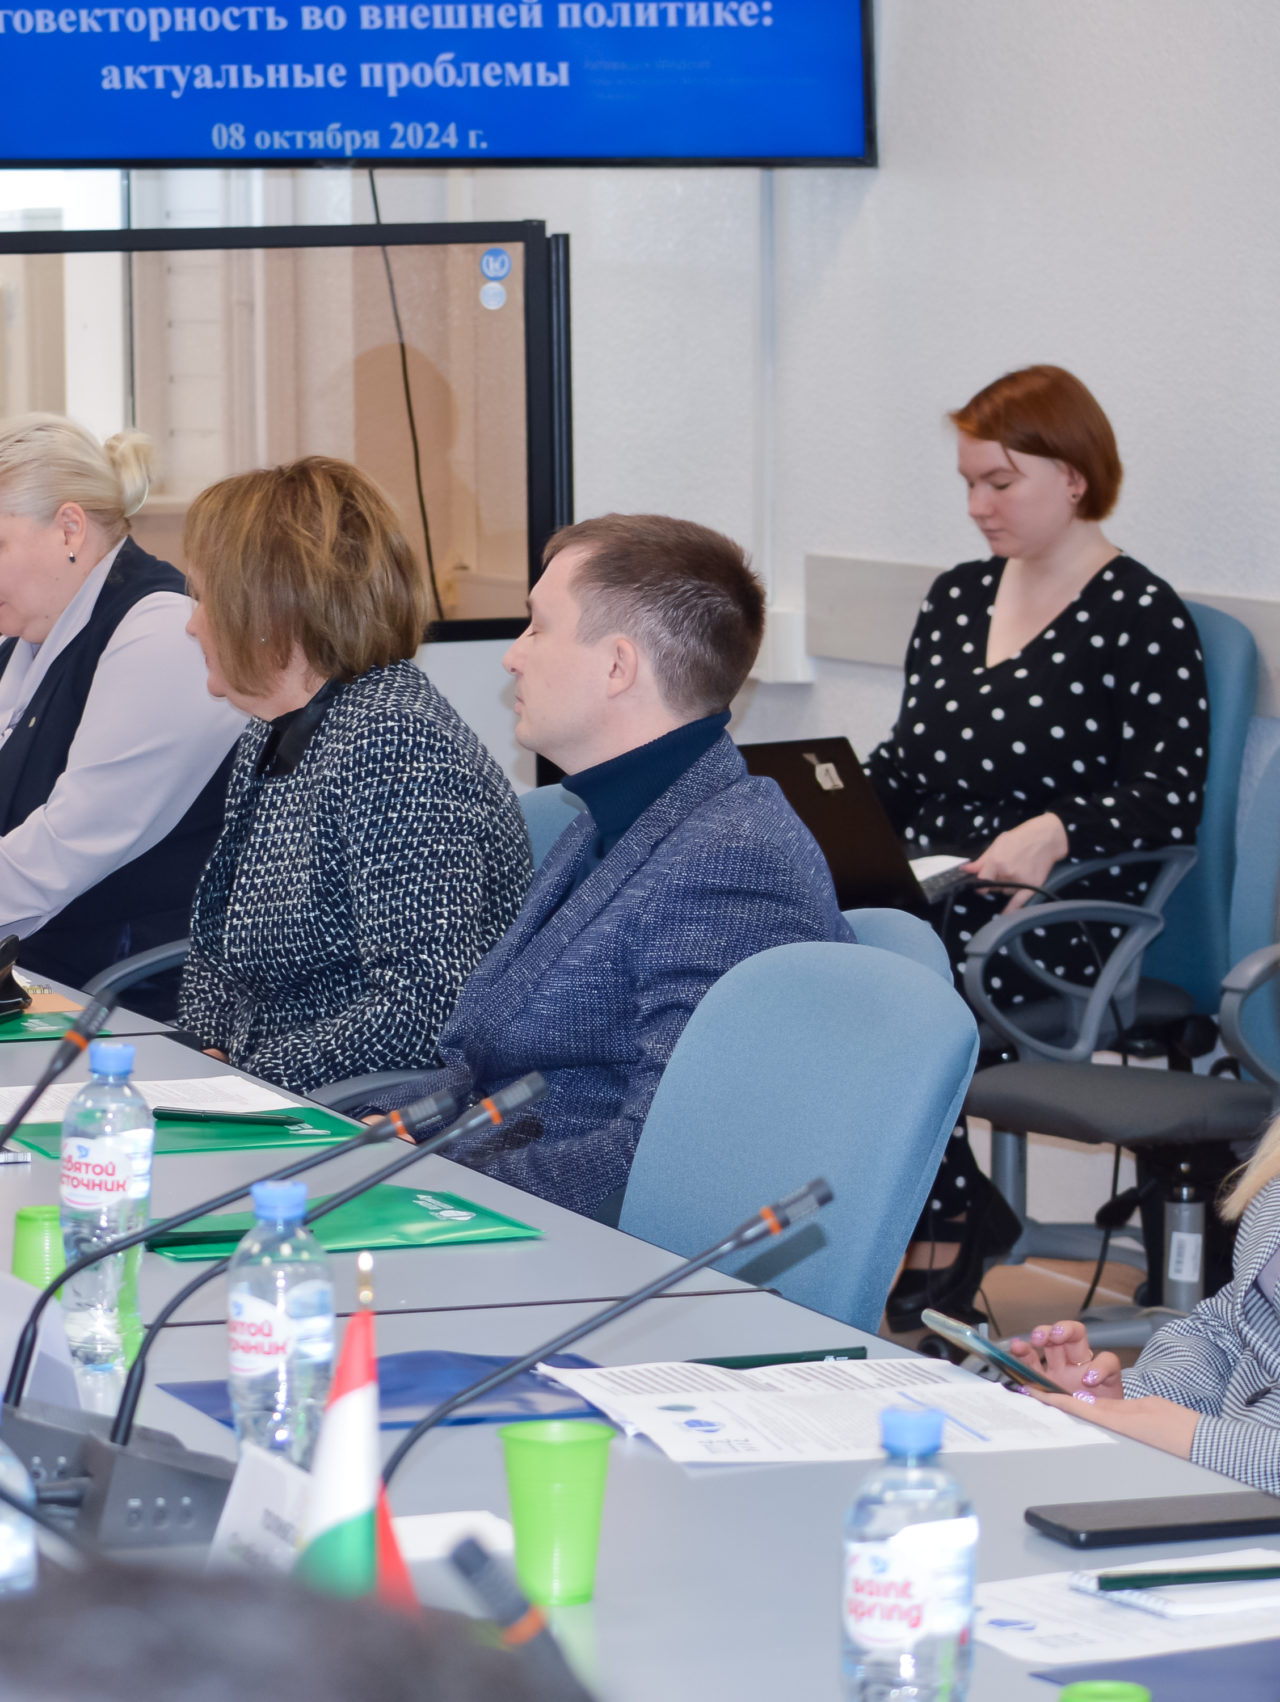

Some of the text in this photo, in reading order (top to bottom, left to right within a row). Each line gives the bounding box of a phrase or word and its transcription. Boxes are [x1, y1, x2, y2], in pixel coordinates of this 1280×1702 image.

[301, 5, 347, 31] во
[360, 0, 543, 30] внешней
[558, 0, 774, 28] политике:
[101, 52, 570, 99] актуальные проблемы
[211, 121, 488, 156] 08 октября 2024 г.
